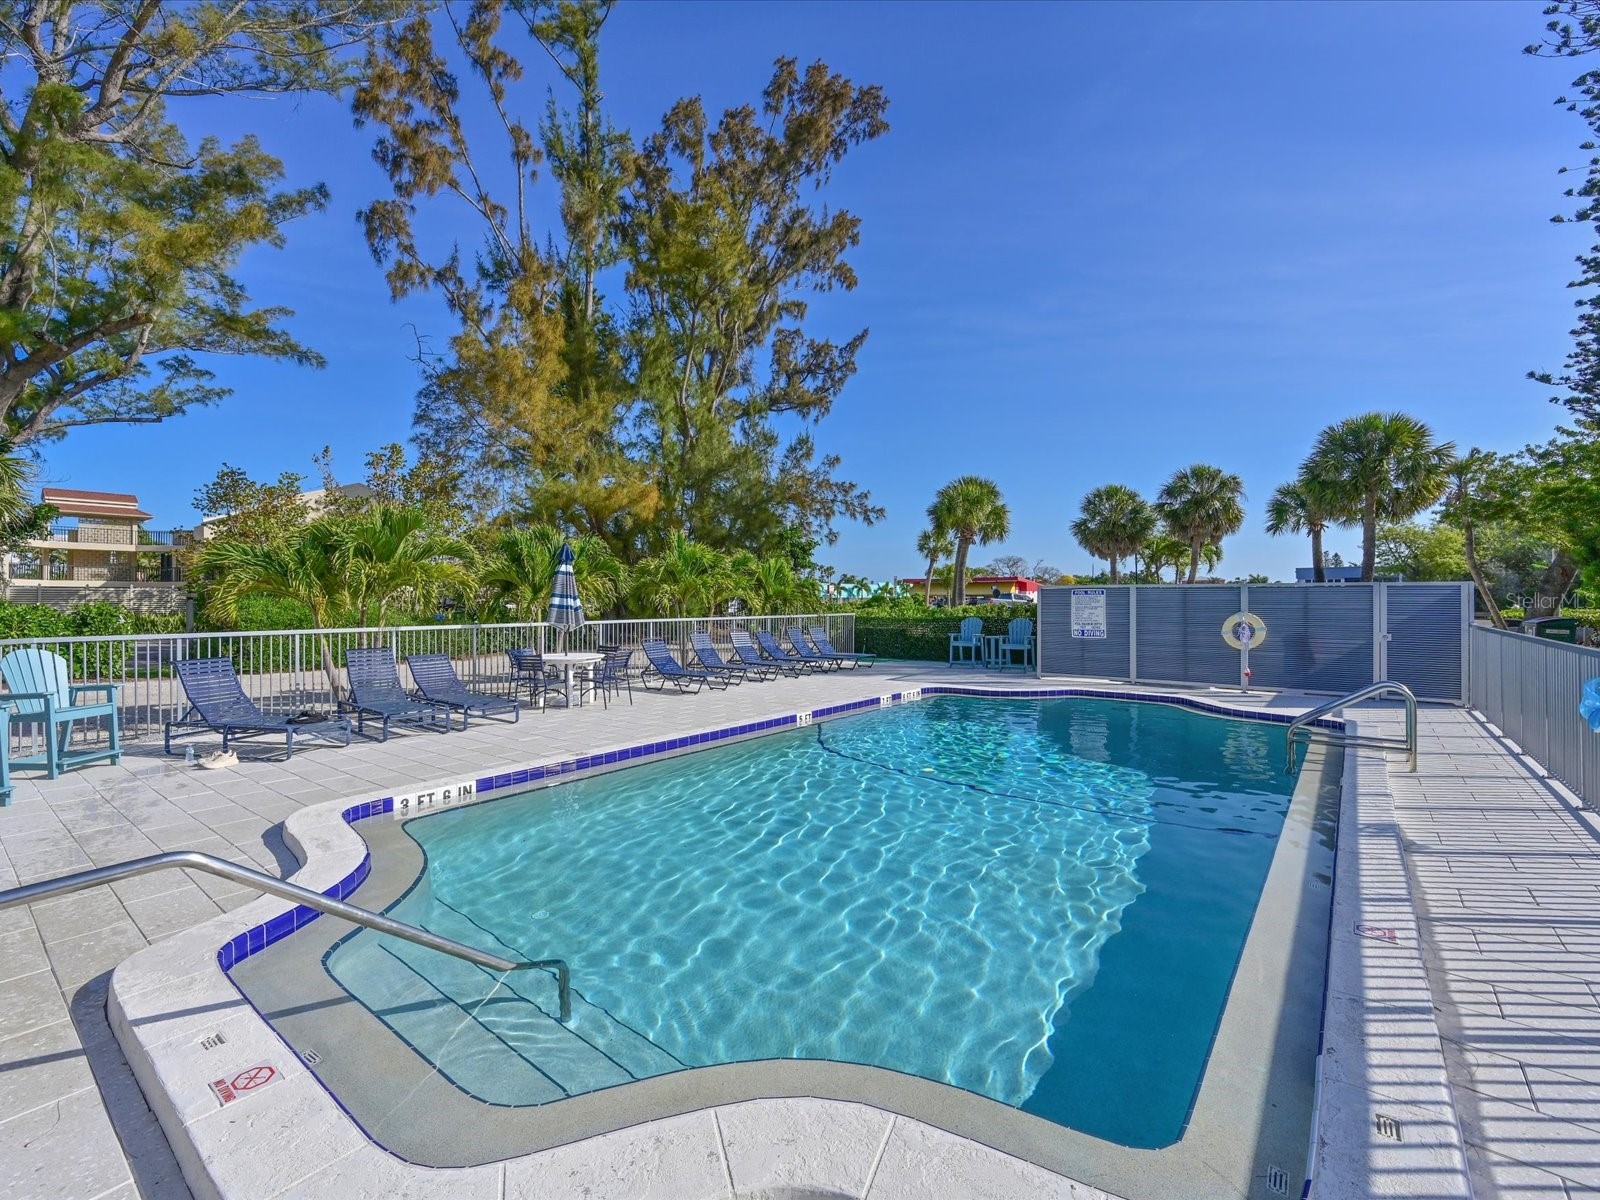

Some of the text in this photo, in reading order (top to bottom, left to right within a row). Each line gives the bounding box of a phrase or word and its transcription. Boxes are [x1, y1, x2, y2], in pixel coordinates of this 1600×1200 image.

[798, 713, 812, 723] 5 FT
[400, 784, 473, 809] 3 FT 6 IN
